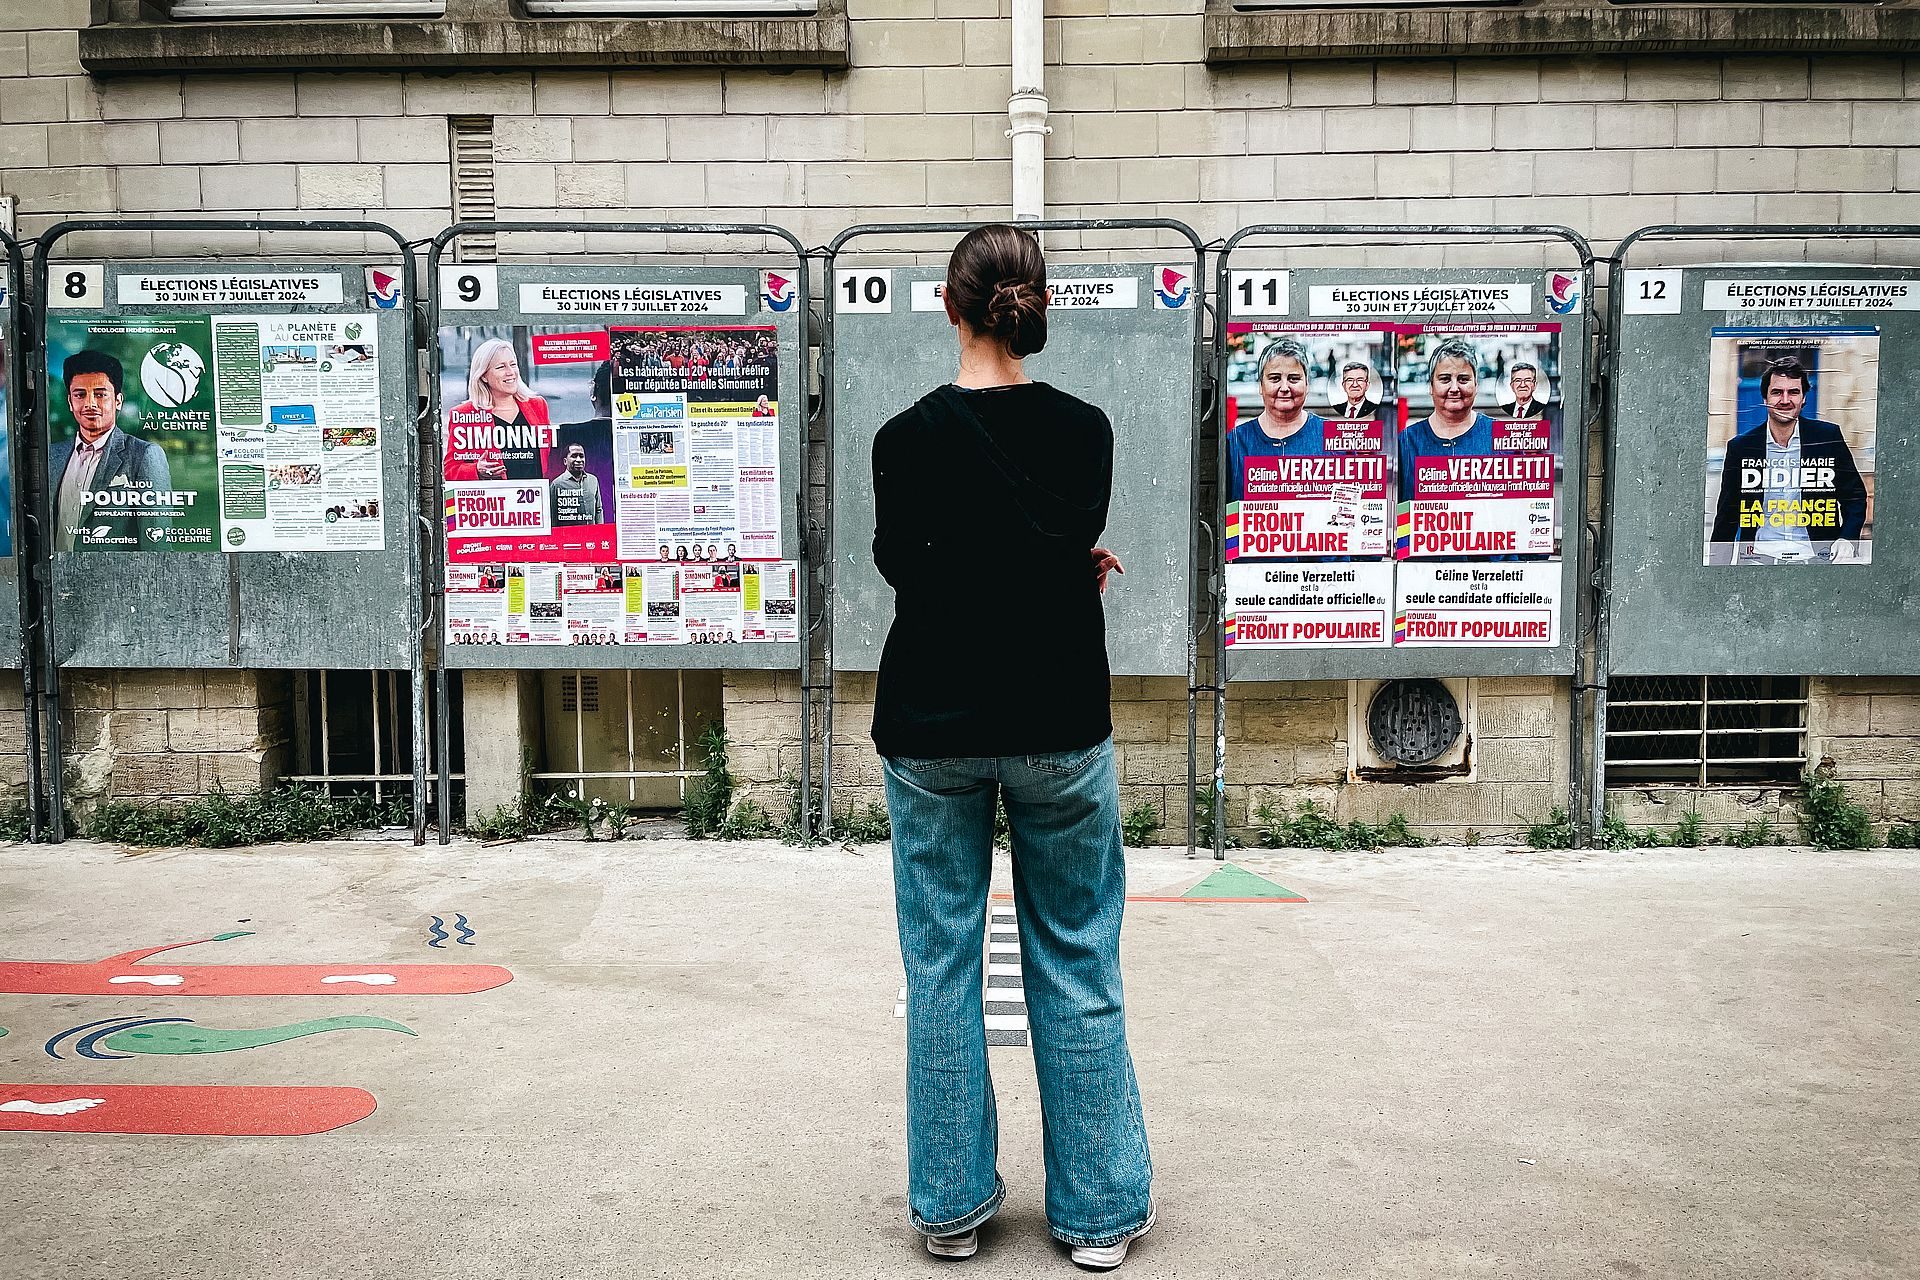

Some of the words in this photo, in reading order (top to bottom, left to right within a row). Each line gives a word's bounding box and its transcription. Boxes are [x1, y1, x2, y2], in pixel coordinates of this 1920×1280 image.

[65, 272, 86, 298] 8
[141, 278, 217, 291] ÉLECTIONS
[223, 277, 319, 290] LÉGISLATIVES
[458, 275, 481, 302] 9
[843, 276, 887, 303] 10
[1640, 281, 1666, 300] 12
[1728, 283, 1807, 297] ÉLECTIONS
[1810, 283, 1908, 297] LÉGISLATIVES
[155, 293, 169, 302] 30
[173, 292, 198, 302] JUIN
[202, 292, 216, 302] ET
[219, 292, 226, 301] 7
[229, 292, 275, 301] JUILLET
[278, 292, 306, 301] 2024
[542, 287, 620, 301] ÉLECTIONS
[625, 287, 722, 301] LÉGISLATIVES
[1238, 278, 1276, 306] 11
[1332, 288, 1409, 302] ÉLECTIONS
[1413, 287, 1509, 301] LÉGISLATIVES
[557, 302, 571, 311] 30
[574, 302, 600, 311] JUIN
[605, 302, 619, 311] ET
[622, 302, 628, 311] 7
[631, 302, 677, 311] JUILLET
[680, 302, 709, 311] 2024
[1071, 297, 1100, 306] 2024
[1346, 303, 1360, 312] 30
[1363, 303, 1390, 312] JUIN
[1393, 303, 1407, 312] ET
[1410, 303, 1417, 312] 7
[1420, 302, 1465, 312] JUILLET
[1468, 302, 1496, 311] 2024
[1741, 298, 1757, 308] 30
[1760, 298, 1787, 308] JUIN
[1789, 298, 1805, 308] ET
[1807, 298, 1814, 308] 7
[1816, 298, 1865, 308] JUILLET
[1867, 298, 1894, 308] 2024
[270, 324, 284, 332] LA
[288, 322, 336, 332] PLANÈTE
[275, 334, 289, 342] AU
[293, 333, 334, 342] CENTRE
[618, 366, 635, 377] Les
[635, 365, 677, 377] habitants
[678, 365, 689, 377] du
[707, 365, 740, 377] veulent
[741, 365, 770, 377] réélire
[625, 378, 644, 390] leur
[644, 378, 680, 392] députée
[681, 378, 717, 390] Danielle
[139, 412, 154, 420] LA
[158, 408, 210, 420] PLANÈTE
[452, 410, 493, 424] Danielle
[653, 405, 683, 418] Parisien
[143, 422, 159, 430] AU
[162, 422, 207, 430] CENTRE
[1336, 423, 1360, 431] soutenue
[1360, 423, 1370, 432] par
[1504, 422, 1528, 431] soutenue
[1528, 422, 1538, 432] par
[453, 425, 561, 450] SIMONNET
[1325, 436, 1381, 451] MÉLENCHON
[1493, 435, 1548, 450] MÉLENCHON
[453, 452, 481, 461] Candidate
[489, 451, 511, 462] Députée
[512, 452, 534, 460] sortante
[1248, 466, 1278, 481] Céline
[1278, 457, 1383, 481] VERZELETTI
[1418, 466, 1448, 481] Céline
[1447, 456, 1550, 480] VERZELETTI
[1741, 458, 1835, 469] FRANÇOIS-MARIE
[1741, 467, 1836, 489] DIDIER
[123, 481, 153, 489] ALIOU
[1418, 482, 1448, 493] Candidate
[1448, 481, 1474, 492] officielle
[1474, 481, 1482, 492] du
[1482, 481, 1508, 492] Nouveau
[1508, 480, 1523, 491] Front
[1523, 480, 1550, 493] Populaire
[80, 491, 198, 506] POURCHET
[557, 488, 584, 497] Laurent
[457, 497, 506, 512] FRONT
[557, 497, 581, 507] SOREL
[1243, 503, 1279, 511] NOUVEAU
[1413, 502, 1449, 511] NOUVEAU
[1740, 500, 1763, 513] LA
[1768, 499, 1837, 513] FRANCE
[458, 511, 541, 528] POPULAIRE
[1243, 512, 1304, 532] FRONT
[1413, 512, 1474, 531] FRONT
[1739, 514, 1765, 528] EN
[1769, 513, 1836, 527] ORDRE
[65, 526, 90, 535] Verts
[165, 527, 211, 535] ÉCOLOGIE
[742, 533, 751, 541] Les
[1535, 527, 1550, 535] PCF
[1242, 532, 1348, 553] POPULAIRE
[1413, 531, 1516, 553] POPULAIRE
[1265, 571, 1299, 583] Céline
[1302, 569, 1355, 583] Verzeletti
[1435, 569, 1469, 582] Céline
[1472, 569, 1524, 581] Verzeletti
[1300, 584, 1311, 592] est
[1470, 583, 1481, 591] est
[1481, 583, 1488, 591] la
[1235, 595, 1265, 606] seule
[1268, 594, 1324, 606] candidate
[1327, 593, 1376, 605] officielle
[1376, 597, 1386, 605] du
[1405, 592, 1435, 604] seule
[1438, 592, 1493, 604] candidate
[1495, 592, 1543, 604] officielle
[1543, 596, 1553, 605] du
[1407, 612, 1437, 620] NOUVEAU
[1237, 623, 1289, 640] FRONT
[1293, 622, 1381, 639] POPULAIRE
[1406, 621, 1458, 638] FRONT
[1461, 621, 1547, 638] POPULAIRE
